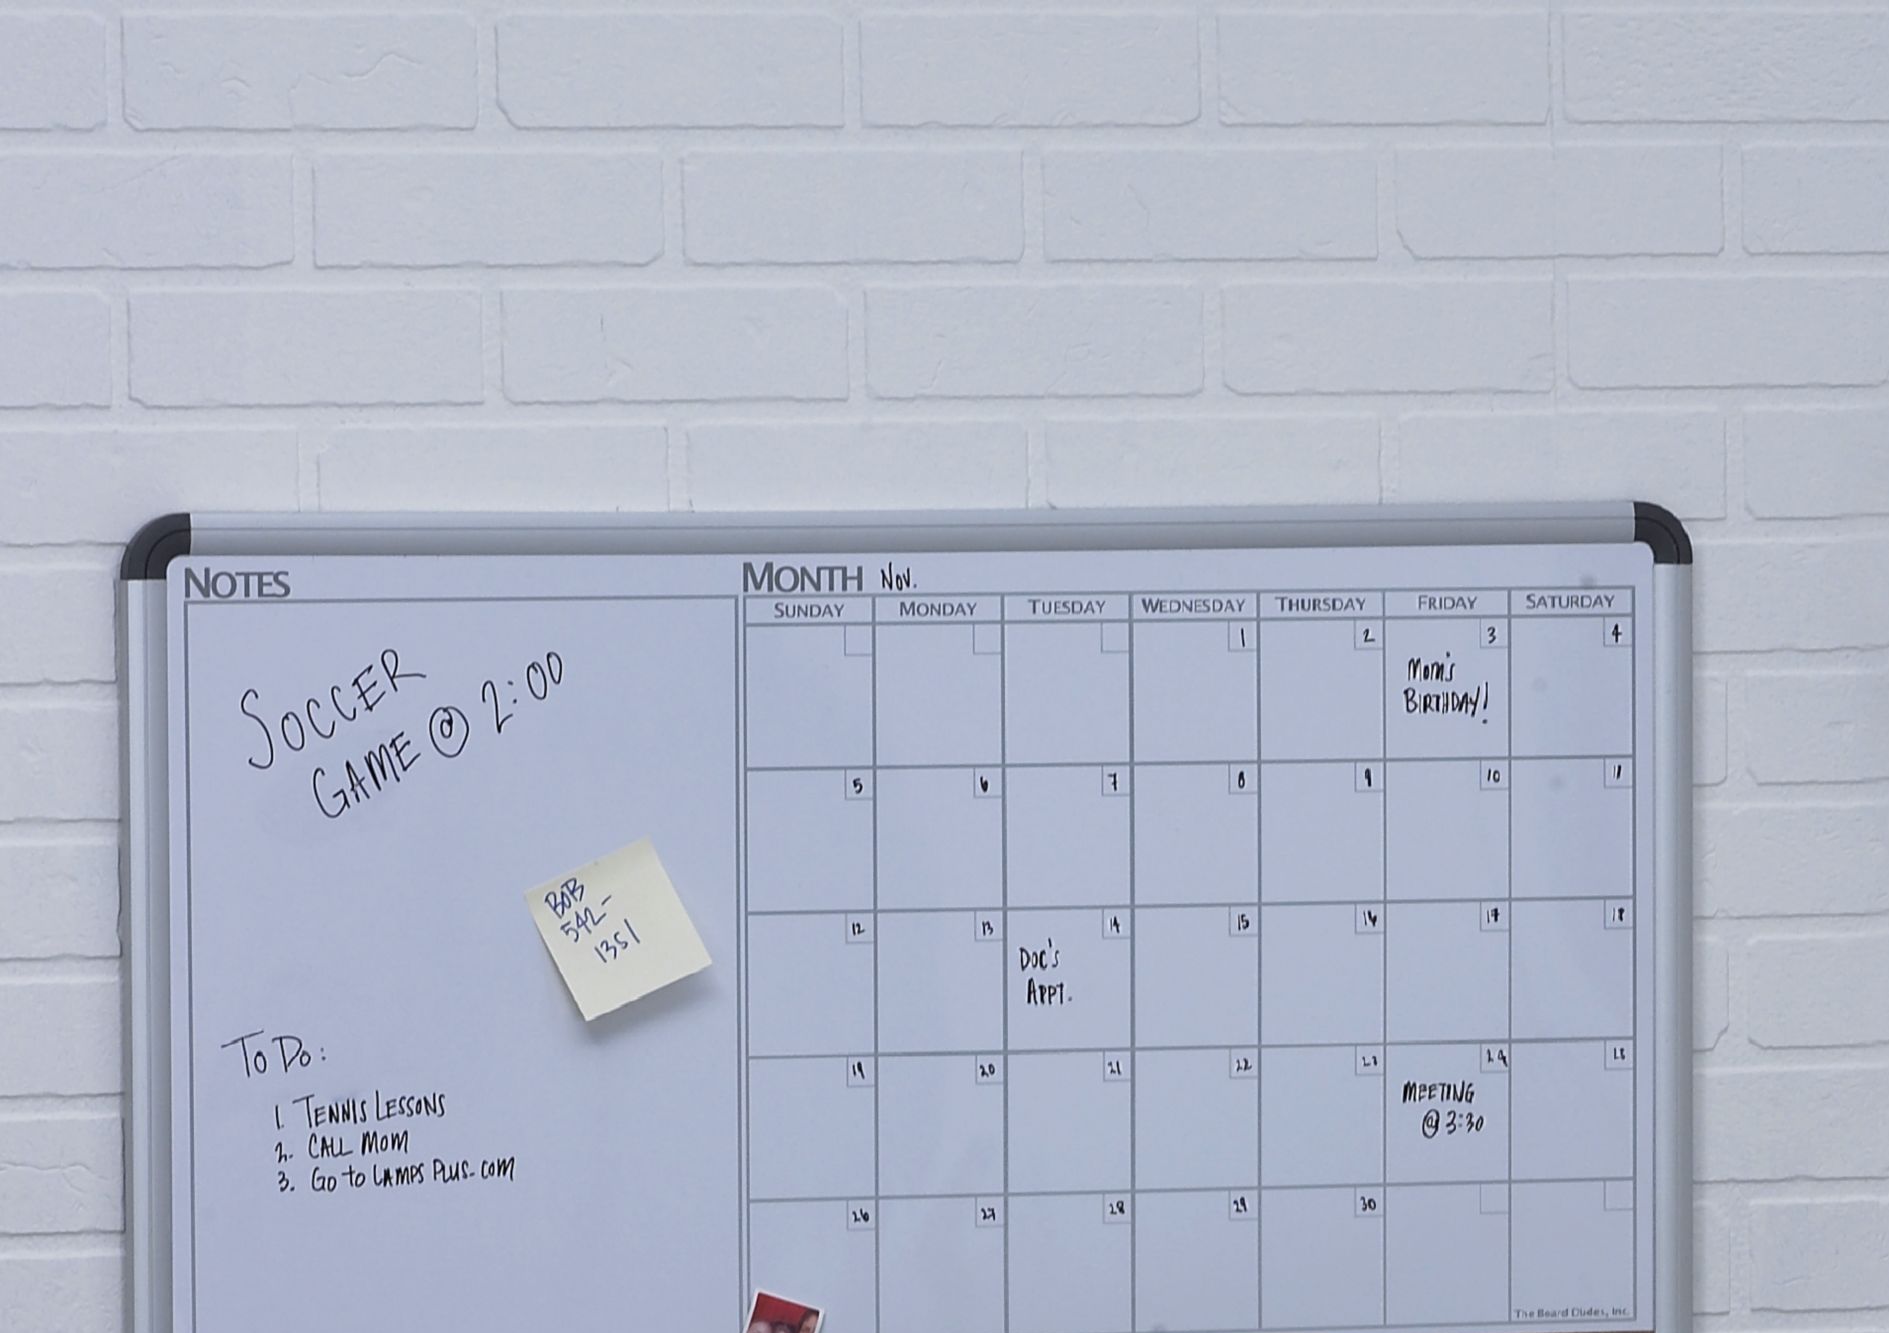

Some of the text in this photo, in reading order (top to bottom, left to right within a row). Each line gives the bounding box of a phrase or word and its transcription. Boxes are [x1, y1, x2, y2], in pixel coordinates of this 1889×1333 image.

[184, 568, 290, 598] NOTES
[743, 562, 862, 592] MONTH
[774, 594, 1614, 618] SUNDAY MONDAY TUESDAY WEDNESDAY THURSDAY FRIDAY SATURDAY
[1241, 621, 1622, 648] 1 2 3 4
[241, 649, 426, 772] SOCCER
[313, 652, 562, 817] GAME @ 2:00
[853, 778, 863, 794] 5
[1108, 772, 1117, 791] 7
[1238, 771, 1245, 789] 8
[1365, 768, 1372, 787] 9
[1487, 768, 1500, 783] 10
[1613, 764, 1621, 780] 11
[544, 877, 584, 920] BOB
[852, 922, 865, 936] 12
[982, 921, 993, 936] 13
[1110, 916, 1120, 934] 14
[1238, 914, 1249, 931] 15
[221, 1031, 326, 1077] To Do:
[852, 1061, 865, 1080] 19
[980, 1063, 995, 1078] 20
[1108, 1060, 1121, 1075] 21
[1236, 1058, 1252, 1072] 22
[1402, 1080, 1475, 1104] MEETING
[292, 1094, 367, 1129] TENNIS
[375, 1090, 445, 1120] LESSONS
[1446, 1110, 1484, 1134] 3:30
[309, 1134, 352, 1159] CALL
[278, 1171, 294, 1191] 3.
[373, 1162, 424, 1186] LAMPS
[852, 1196, 1376, 1223] 26 27 28 29 30
[1514, 1308, 1533, 1319] The
[1538, 1309, 1568, 1317] Board
[1611, 1306, 1629, 1317] Inc.
